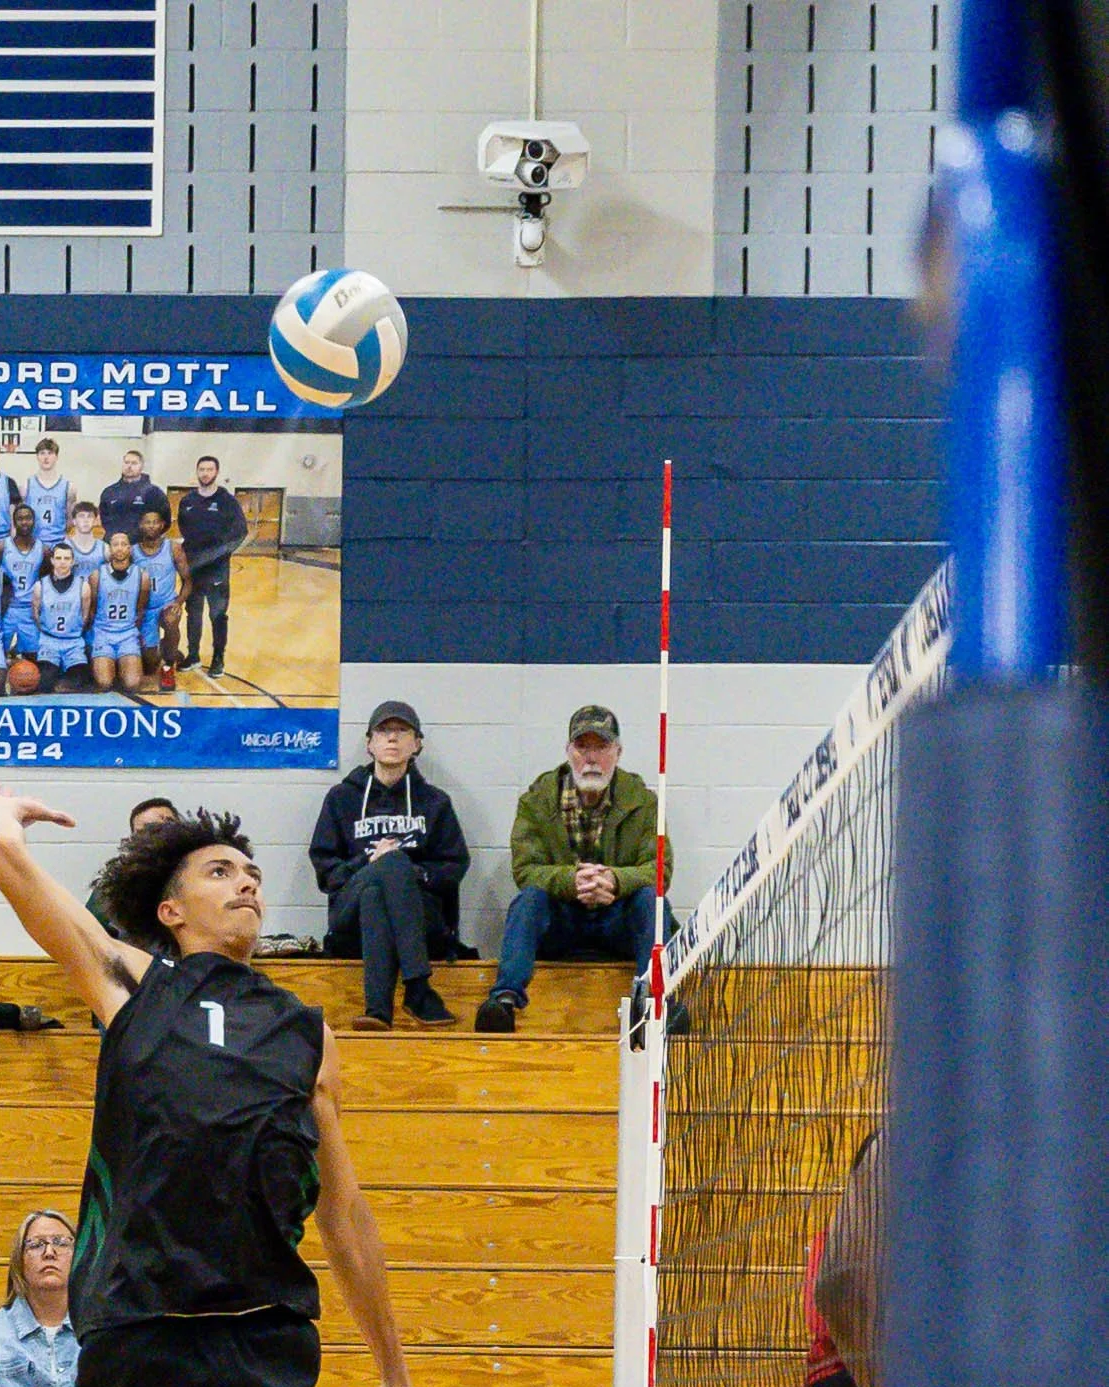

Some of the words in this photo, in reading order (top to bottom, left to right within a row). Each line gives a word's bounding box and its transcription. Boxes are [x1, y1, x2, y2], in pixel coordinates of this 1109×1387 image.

[102, 362, 229, 385] MOTT
[42, 509, 52, 524] 4
[18, 576, 27, 591] 5
[108, 604, 128, 620] 22
[56, 616, 66, 632] 2
[199, 1000, 225, 1048] 1
